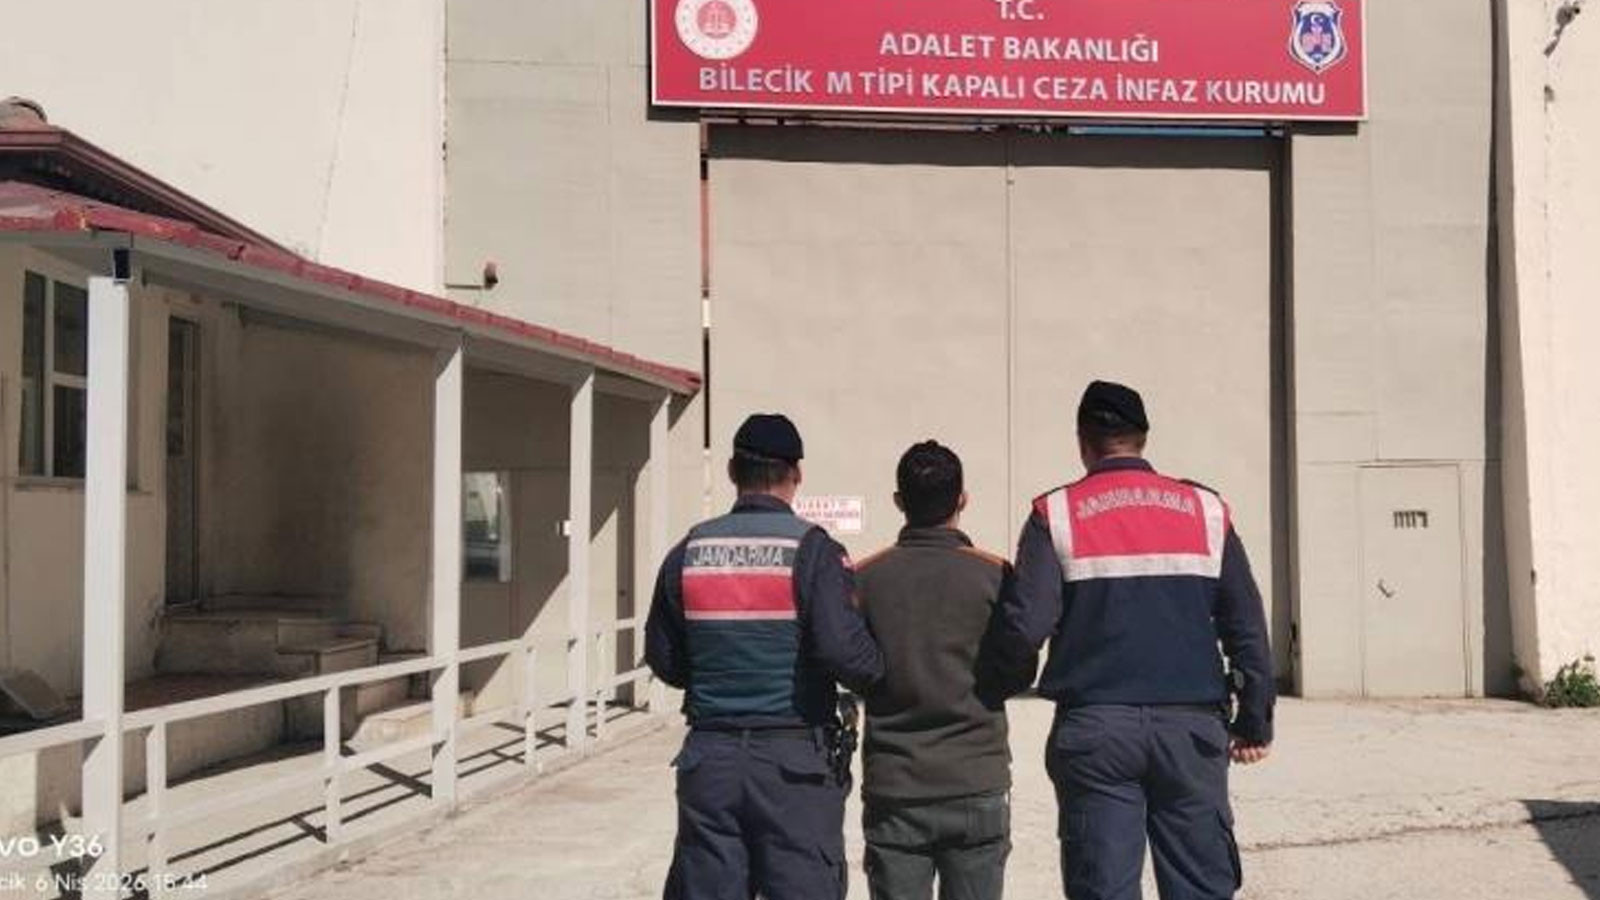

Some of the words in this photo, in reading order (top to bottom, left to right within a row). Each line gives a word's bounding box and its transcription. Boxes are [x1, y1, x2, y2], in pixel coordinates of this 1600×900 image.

[995, 0, 1044, 20] T.C.
[880, 33, 996, 58] ADALET
[1003, 34, 1159, 63] BAKANLIĞI
[699, 62, 813, 93] BİLECİK
[826, 71, 852, 94] M
[858, 68, 914, 96] TİPİ
[921, 73, 1025, 100] KAPALI
[1033, 76, 1108, 101] CEZA
[1116, 73, 1198, 102] İNFAZ
[1206, 80, 1325, 106] KURUMU
[692, 545, 784, 566] JANDARMA
